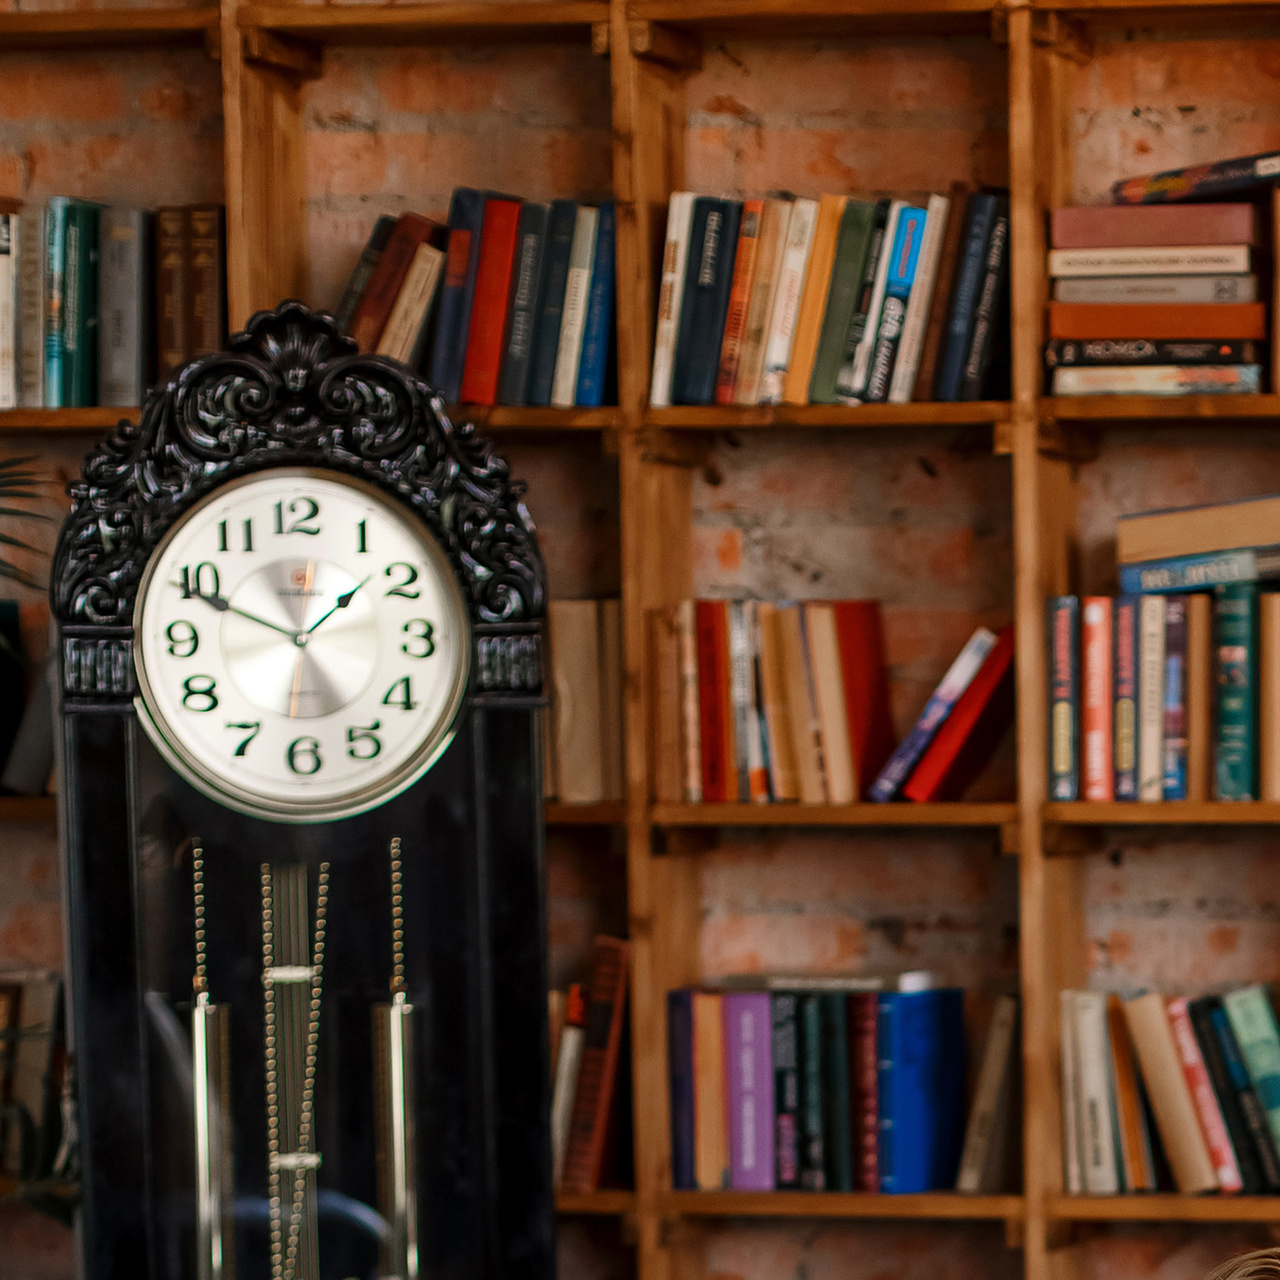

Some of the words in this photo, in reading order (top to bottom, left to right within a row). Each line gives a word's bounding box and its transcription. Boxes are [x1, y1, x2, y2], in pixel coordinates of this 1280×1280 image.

[273, 497, 320, 535] 12
[218, 518, 254, 551] 11
[357, 518, 368, 552] 1
[181, 562, 221, 599] 10
[384, 563, 420, 599] 2
[167, 621, 199, 657] 9
[402, 619, 435, 658] 3
[183, 675, 218, 711] 8
[382, 676, 417, 710] 4
[226, 722, 260, 756] 7
[286, 737, 322, 774] 6
[347, 720, 381, 759] 5
